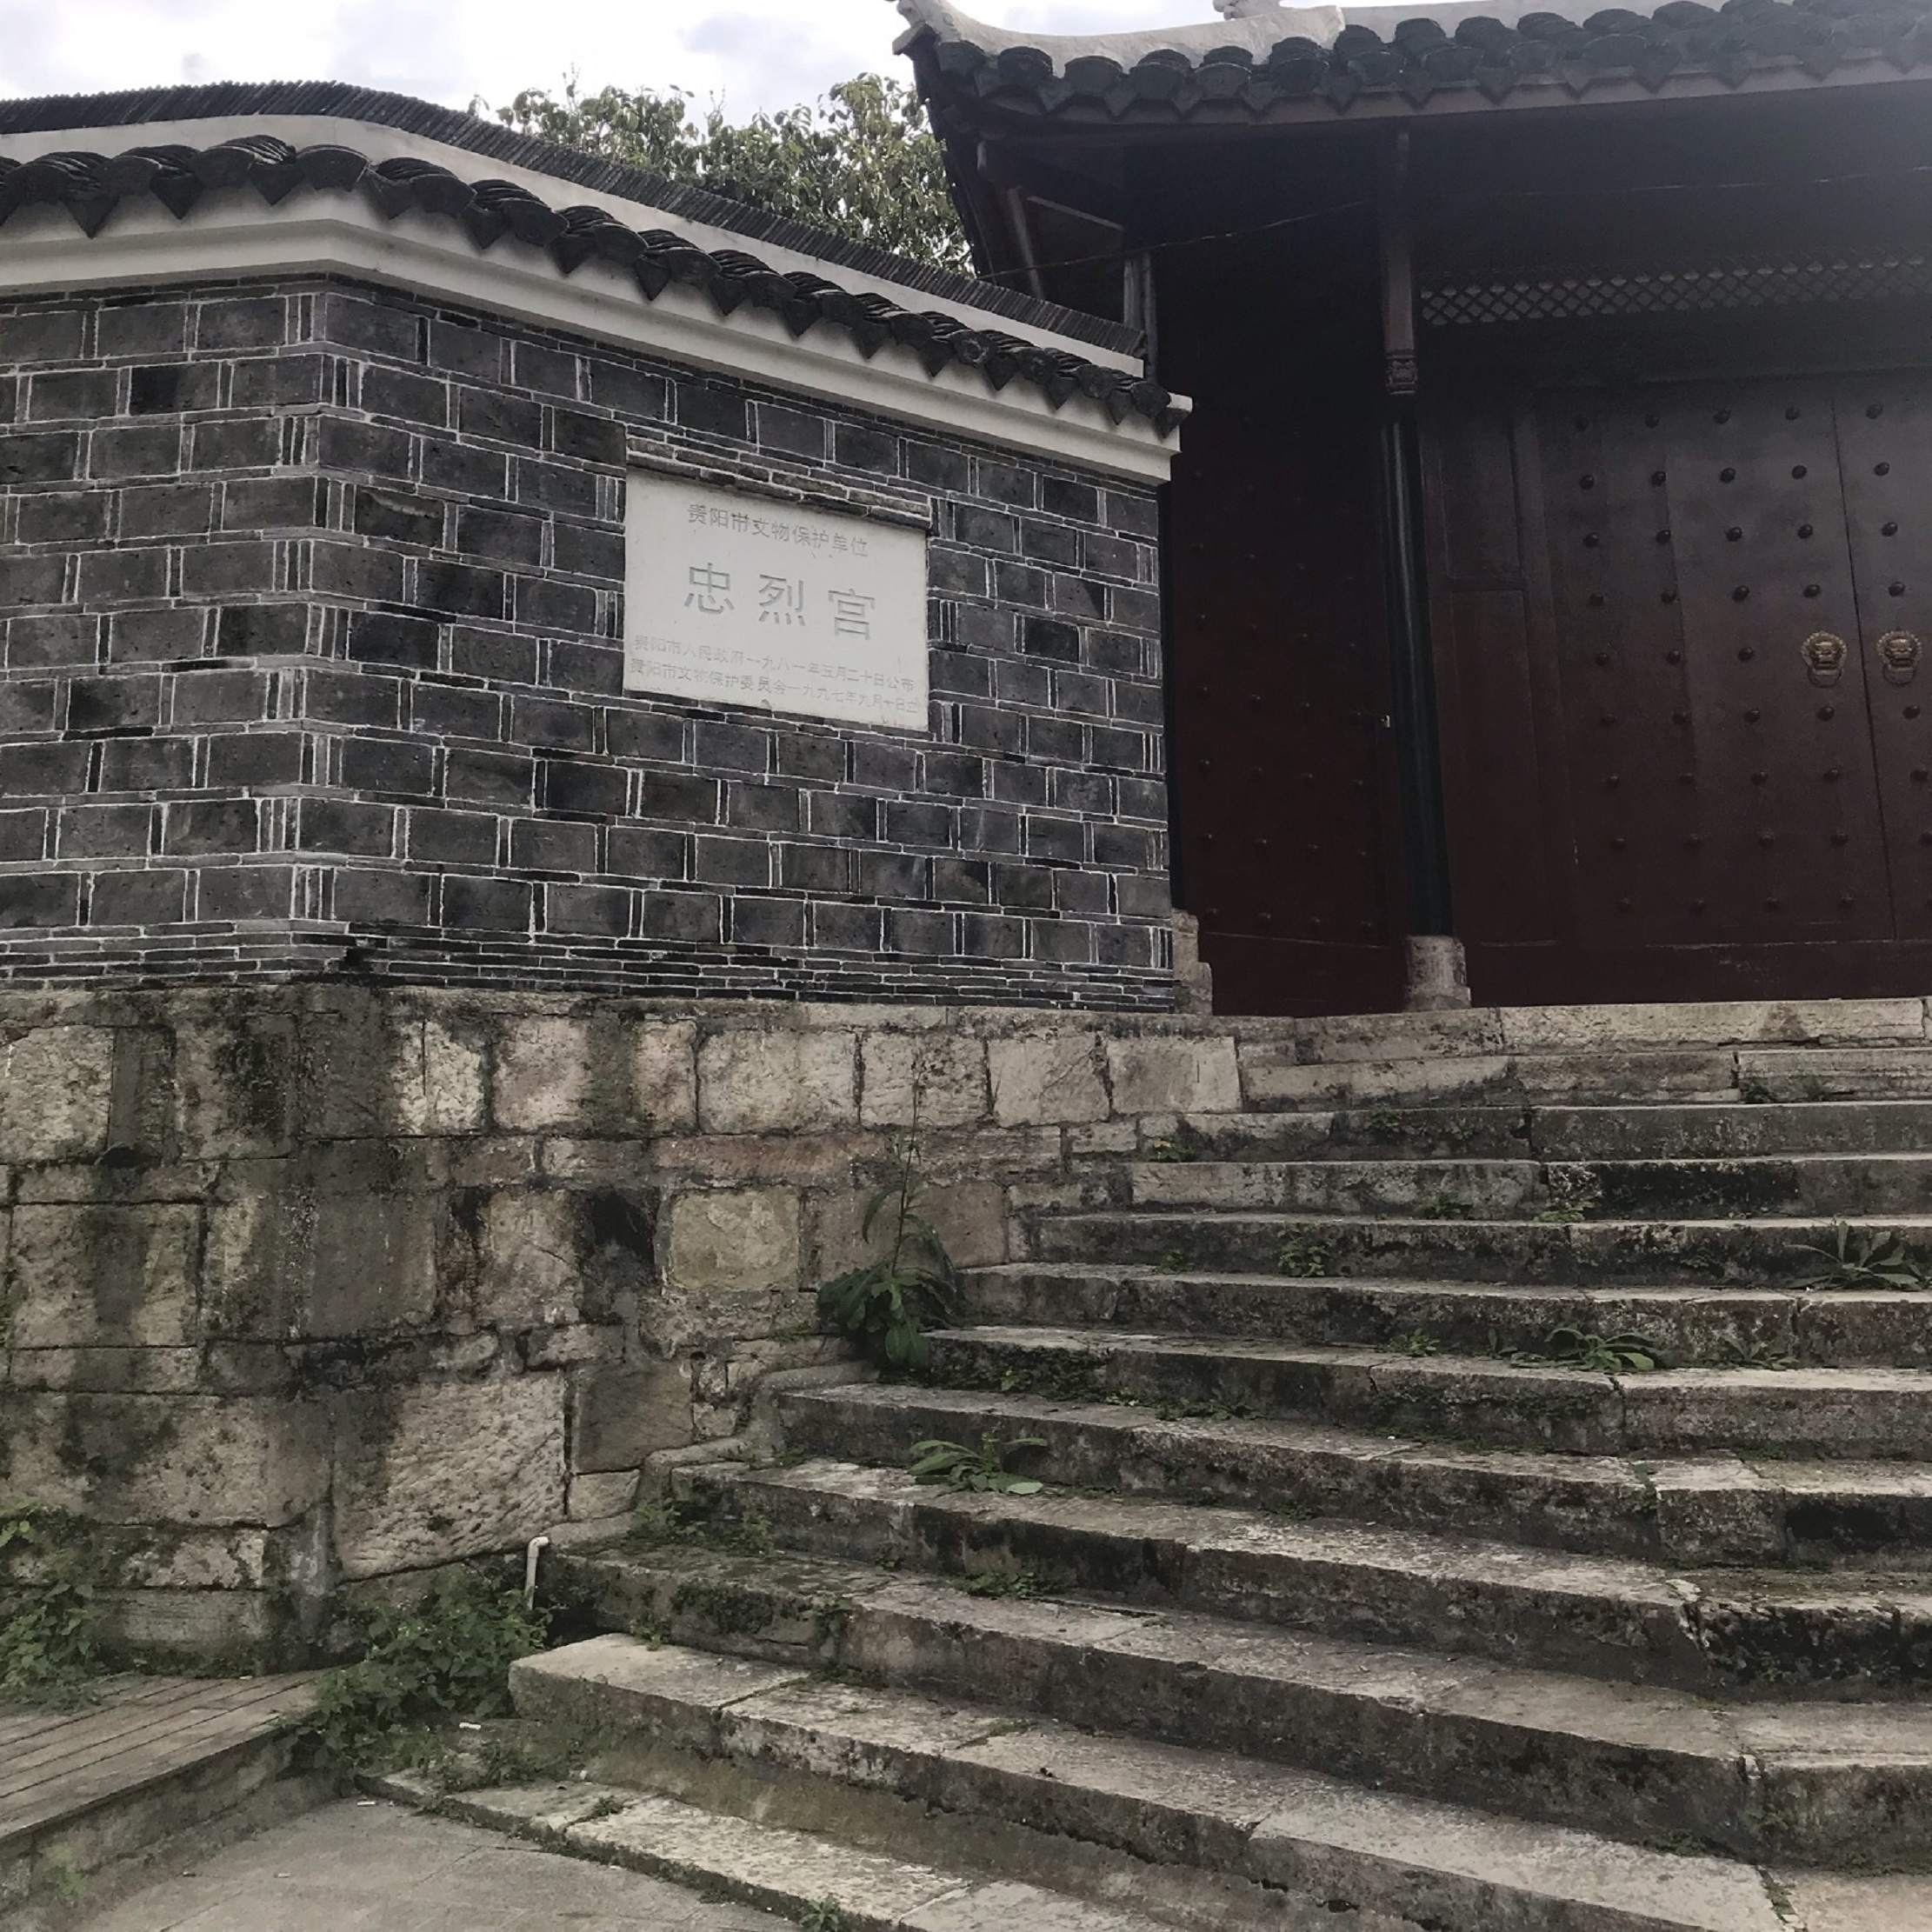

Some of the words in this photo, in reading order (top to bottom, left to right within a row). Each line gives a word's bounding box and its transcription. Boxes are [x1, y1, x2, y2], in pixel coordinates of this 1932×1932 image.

[687, 503, 869, 557] 贵阳市文物保护单位
[683, 563, 876, 641] 忠烈宫
